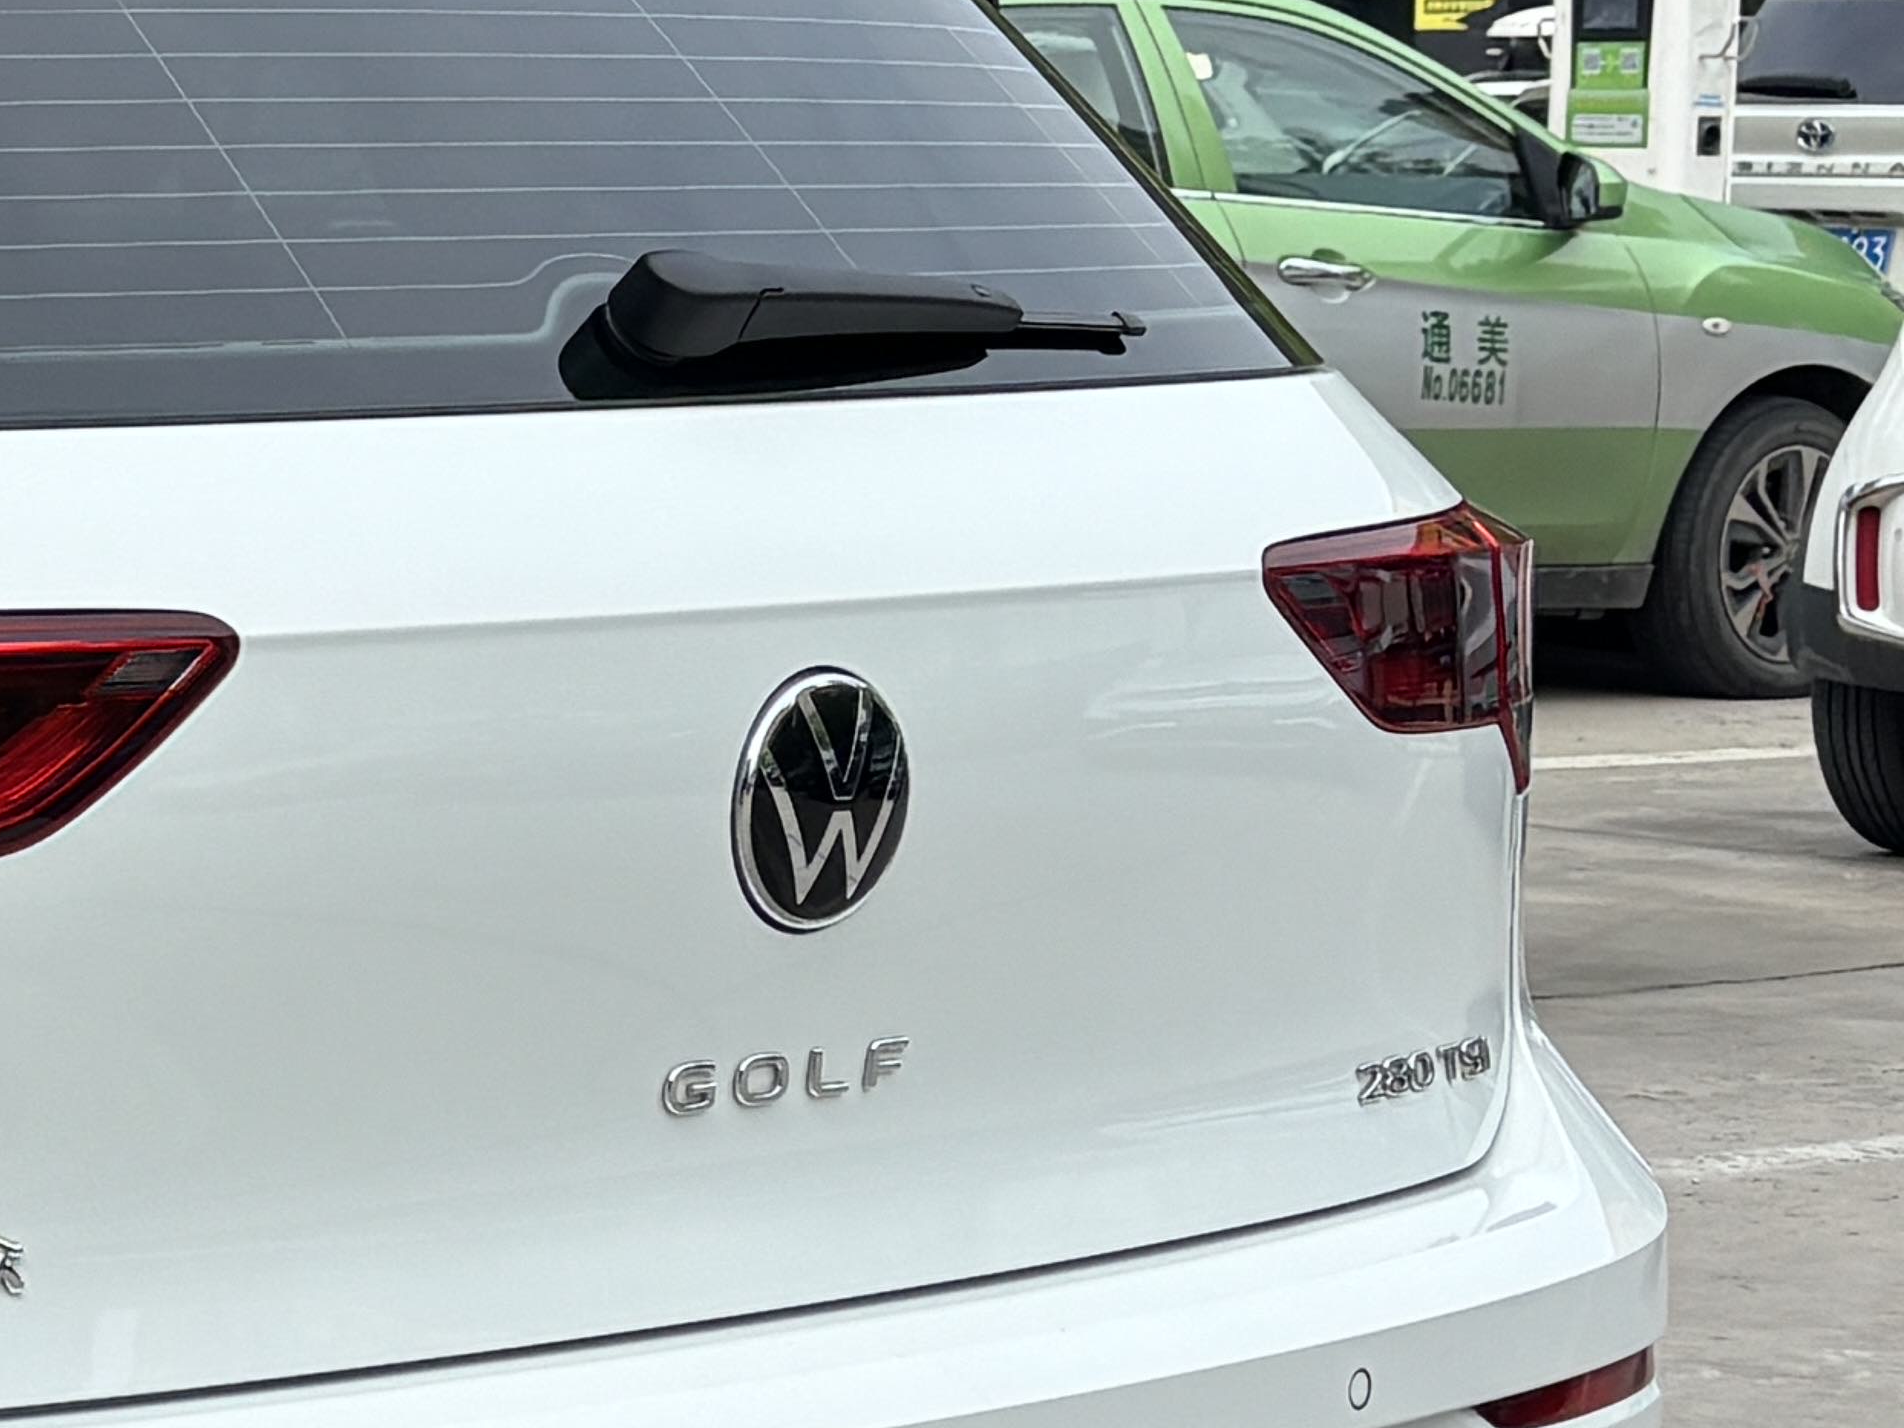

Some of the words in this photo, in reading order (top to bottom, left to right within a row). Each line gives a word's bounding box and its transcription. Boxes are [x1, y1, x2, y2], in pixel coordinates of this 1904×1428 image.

[1421, 365, 1506, 406] No.06681
[662, 1035, 911, 1118] GOLF
[1355, 1051, 1436, 1107] 280
[1436, 1035, 1491, 1087] TSI
